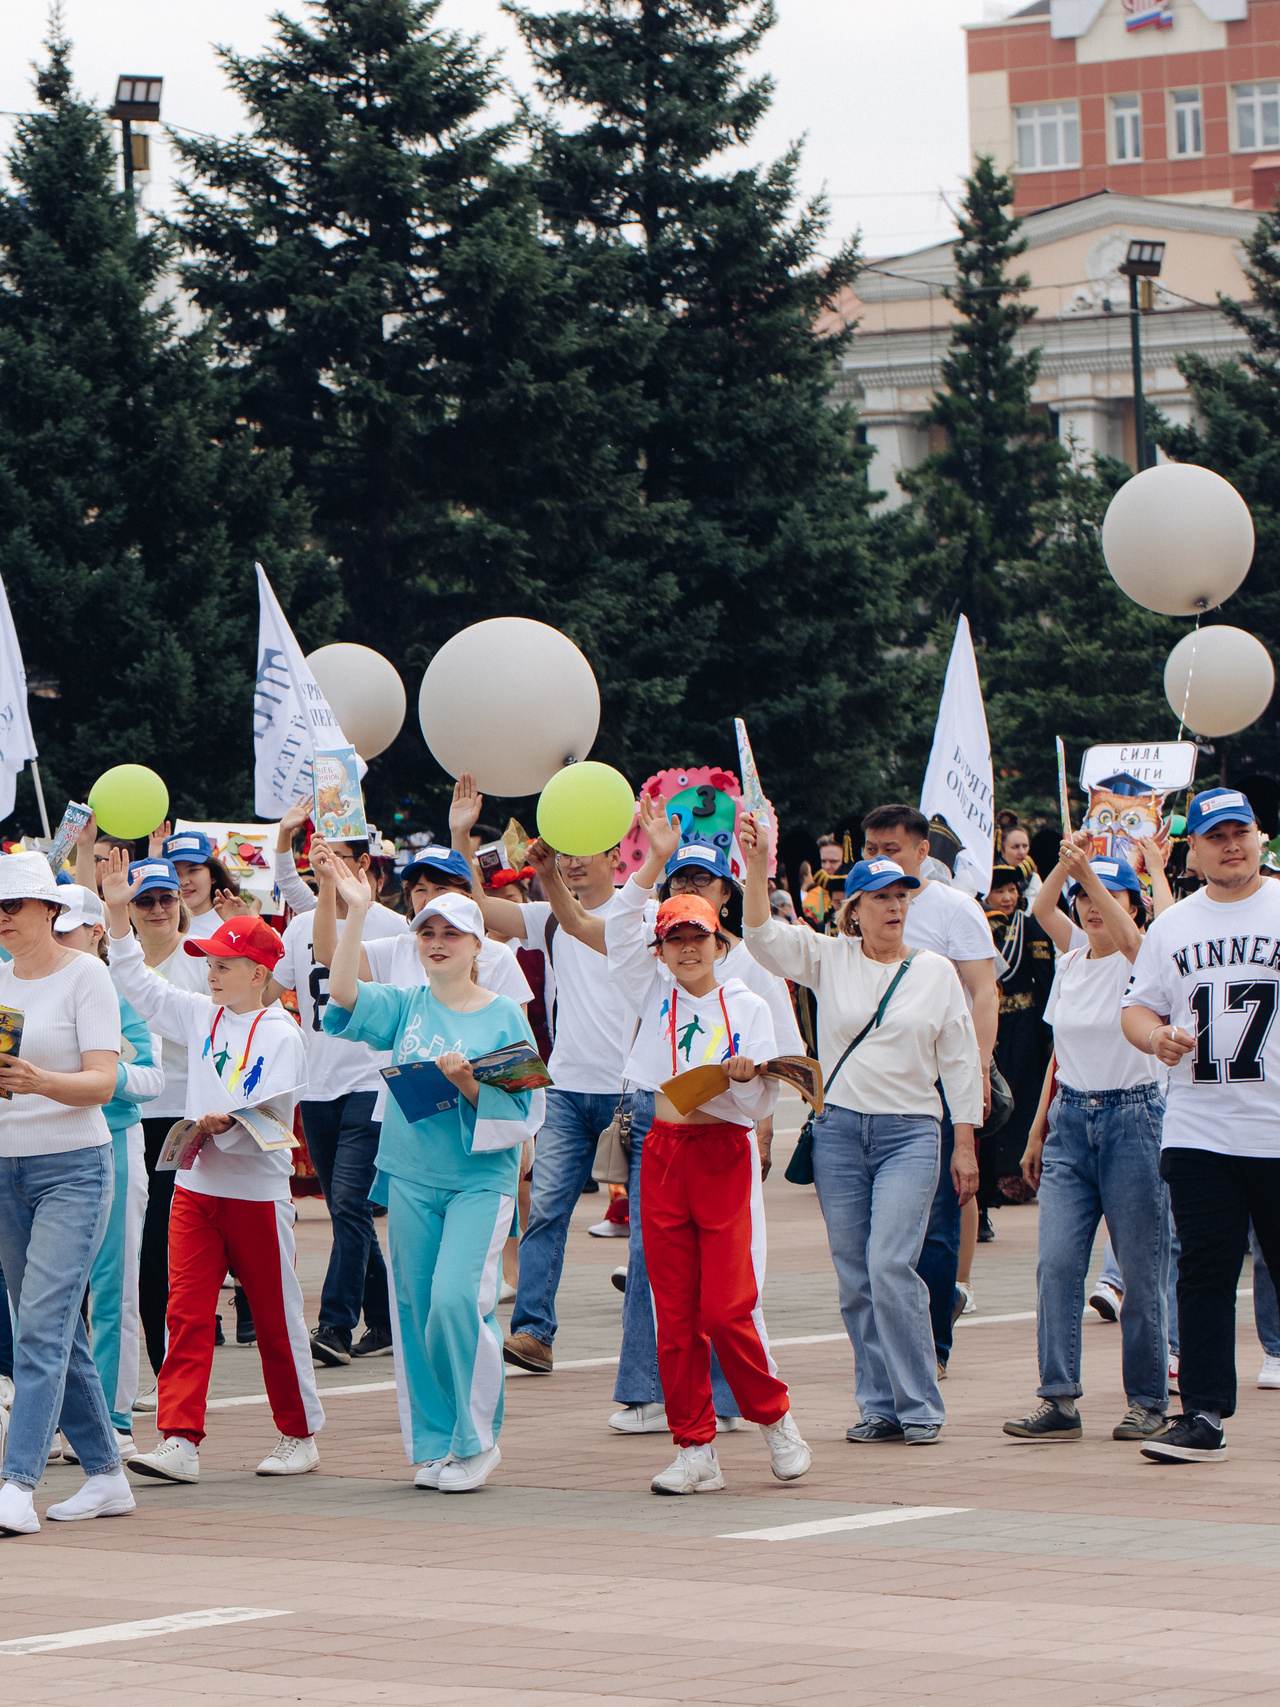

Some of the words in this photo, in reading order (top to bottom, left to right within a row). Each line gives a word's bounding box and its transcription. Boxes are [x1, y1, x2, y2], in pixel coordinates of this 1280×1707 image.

[1119, 746, 1160, 762] СИЛА
[1112, 767, 1163, 781] КИГИ
[1188, 979, 1280, 1084] 17
